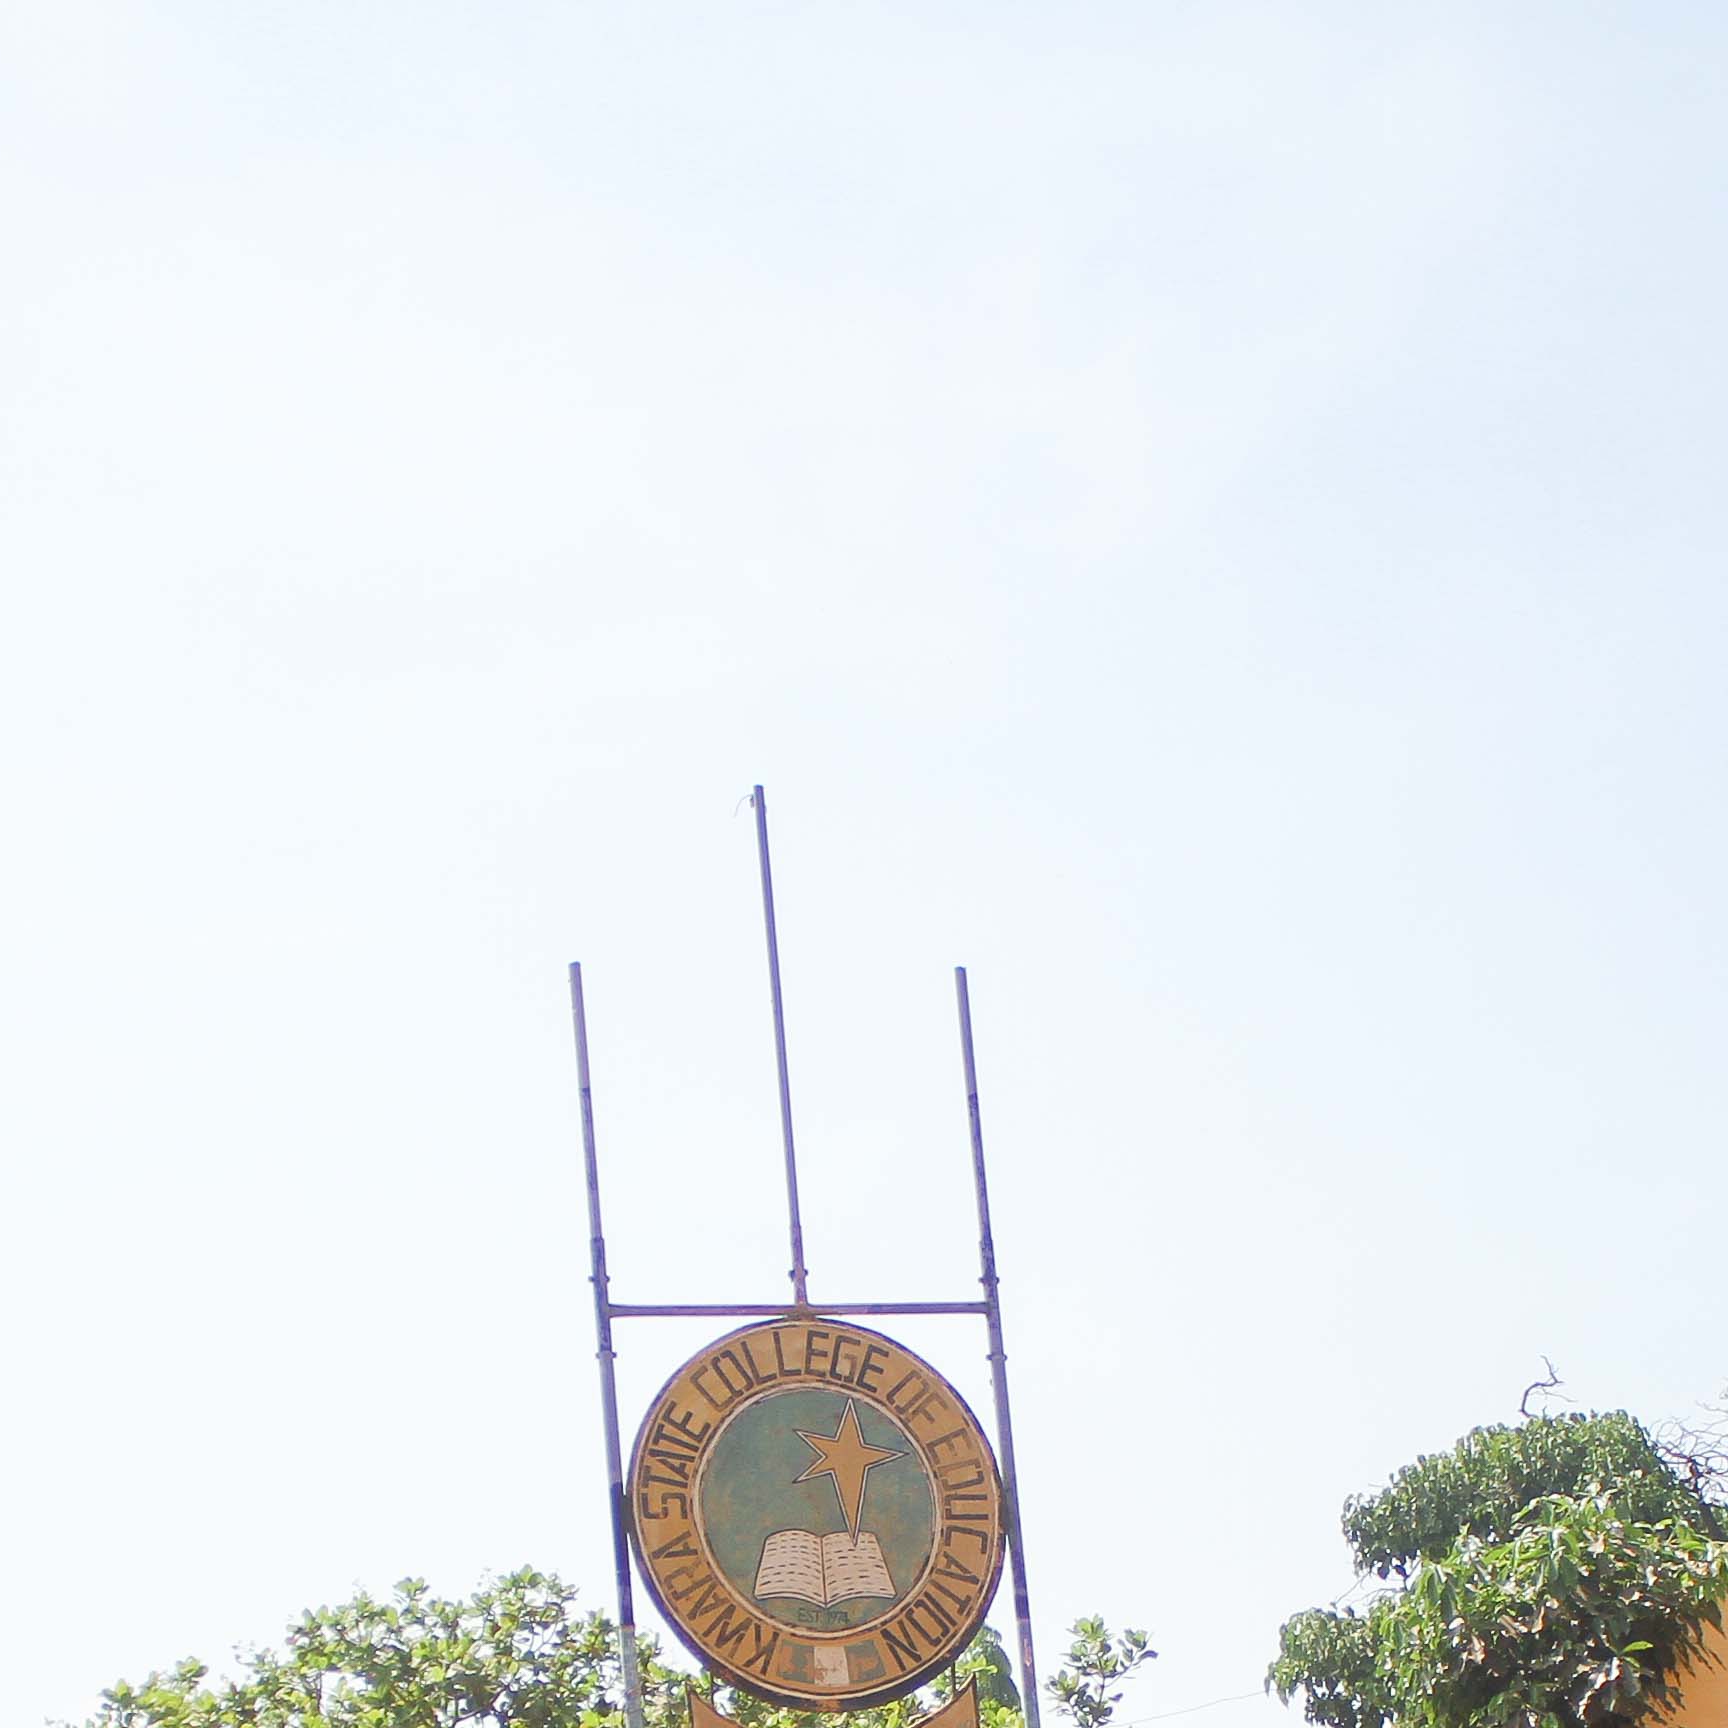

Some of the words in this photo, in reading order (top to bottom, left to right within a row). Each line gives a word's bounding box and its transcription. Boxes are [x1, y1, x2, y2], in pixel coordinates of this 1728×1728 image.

[690, 1330, 889, 1408] COLLEGE
[887, 1369, 947, 1426] OF
[642, 1401, 711, 1520] STATE
[652, 1530, 780, 1675] KWARA
[880, 1415, 989, 1672] EDUCATION
